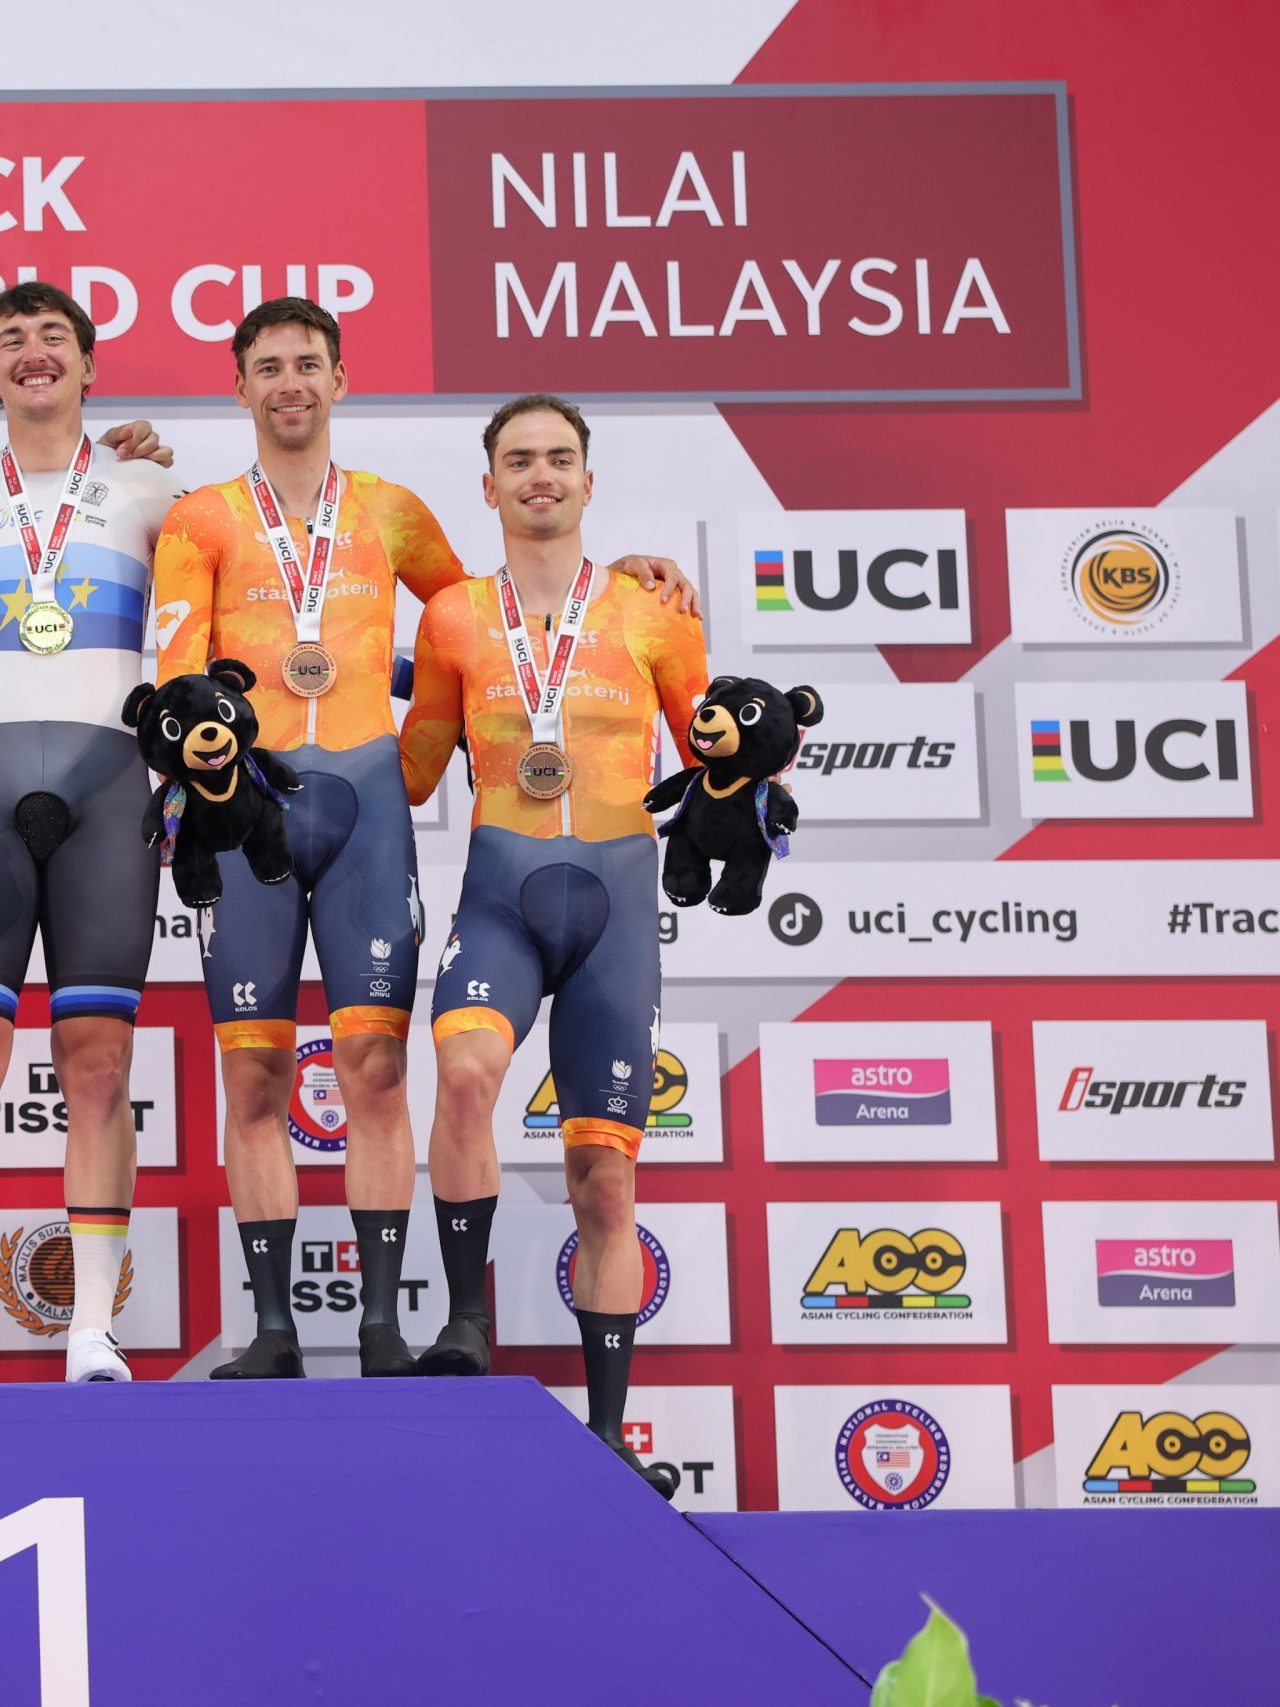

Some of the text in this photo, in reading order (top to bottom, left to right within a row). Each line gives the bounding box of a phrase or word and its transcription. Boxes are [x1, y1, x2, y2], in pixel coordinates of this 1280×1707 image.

[491, 151, 747, 228] NILAI
[494, 258, 1011, 338] MALAYSIA
[70, 473, 82, 491] UCI
[19, 506, 29, 526] UCI
[322, 504, 333, 523] UCI
[45, 551, 57, 570] UCI
[278, 541, 291, 561] UCI
[793, 549, 959, 610] UCI
[1102, 567, 1152, 589] KBS
[308, 588, 319, 608] UCI
[569, 601, 581, 620] UCI
[35, 624, 57, 633] UCI
[516, 642, 527, 662] UCI
[299, 666, 320, 675] UCI
[545, 688, 557, 709] UCI
[786, 733, 956, 775] sports
[1070, 719, 1239, 781] UCI
[533, 767, 556, 776] UCI
[848, 901, 1078, 943] uci_cycling
[851, 1064, 912, 1086] astro
[1058, 1067, 1247, 1115] isports
[856, 1104, 909, 1120] Arena
[523, 1131, 555, 1139] ASIAN
[19, 1226, 71, 1283] MAJLIS SUKA
[1134, 1245, 1196, 1267] astro
[1139, 1285, 1192, 1302] Arena
[800, 1311, 973, 1320] ASIAN CYCLING CONFEDERATION
[840, 1402, 888, 1446] NATIONAL
[895, 1402, 942, 1441] CYCLING
[903, 1446, 948, 1510] FEDERATION
[1083, 1496, 1259, 1505] ASIAN CYCLING CONFEDERATION
